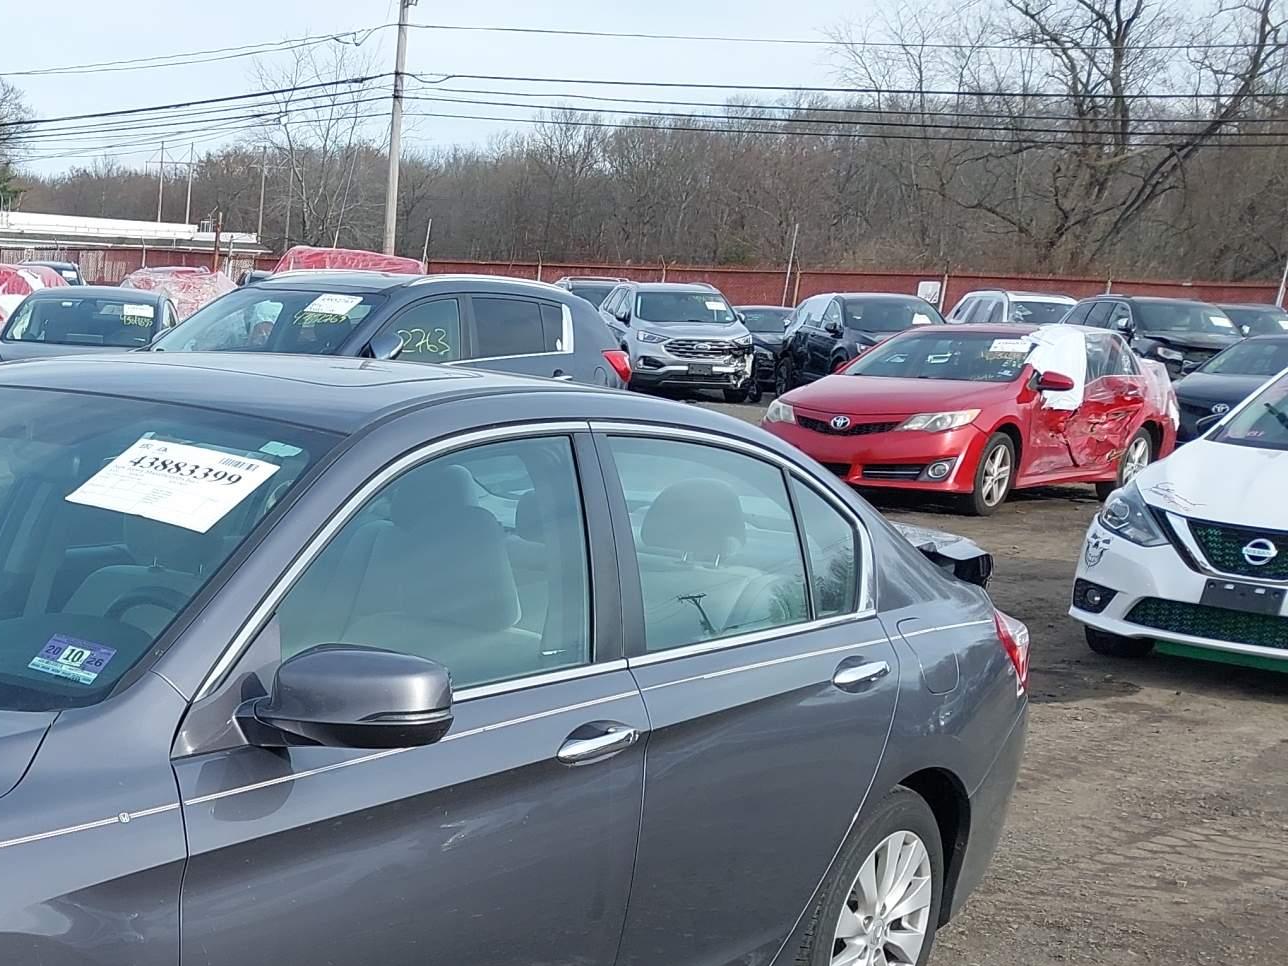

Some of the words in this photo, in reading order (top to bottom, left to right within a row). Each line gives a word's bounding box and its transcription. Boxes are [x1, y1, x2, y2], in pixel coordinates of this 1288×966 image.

[397, 328, 451, 355] 2763
[129, 455, 243, 486] 43883399
[46, 645, 62, 657] 20
[62, 648, 85, 663] 10
[86, 657, 104, 667] 26
